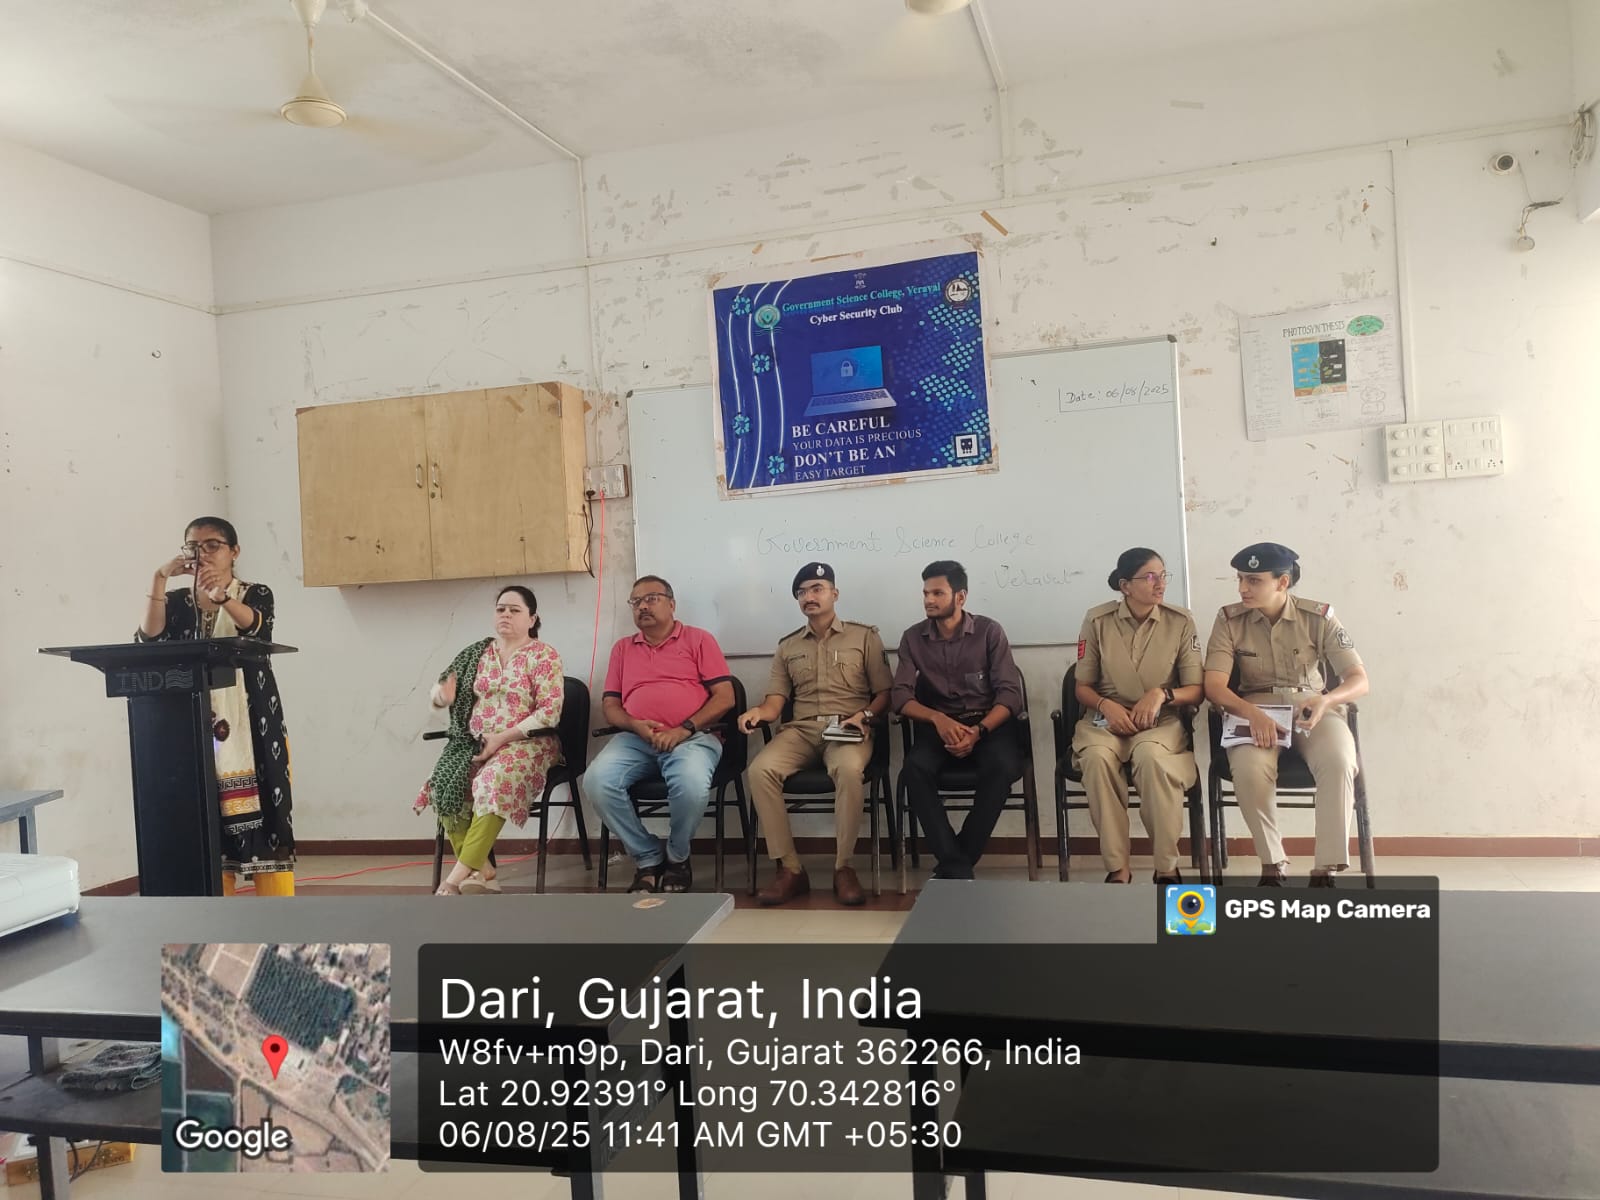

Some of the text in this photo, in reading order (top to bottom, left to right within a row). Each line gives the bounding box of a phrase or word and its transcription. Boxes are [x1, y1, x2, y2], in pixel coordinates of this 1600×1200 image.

[782, 297, 835, 312] Government
[836, 292, 868, 304] Science
[870, 287, 904, 301] College,
[809, 304, 903, 326] Cyber Security Club
[1282, 320, 1346, 338] PHOTOSYNTHESIS
[1065, 389, 1101, 404] Date:
[792, 416, 890, 438] BE CAREFUL
[792, 428, 922, 451] YOUR DATA IS PRECIOUS
[794, 444, 897, 468] DON'T BE AN
[795, 465, 866, 481] EASY TARGET
[894, 526, 955, 557] Science
[970, 525, 1036, 553] College
